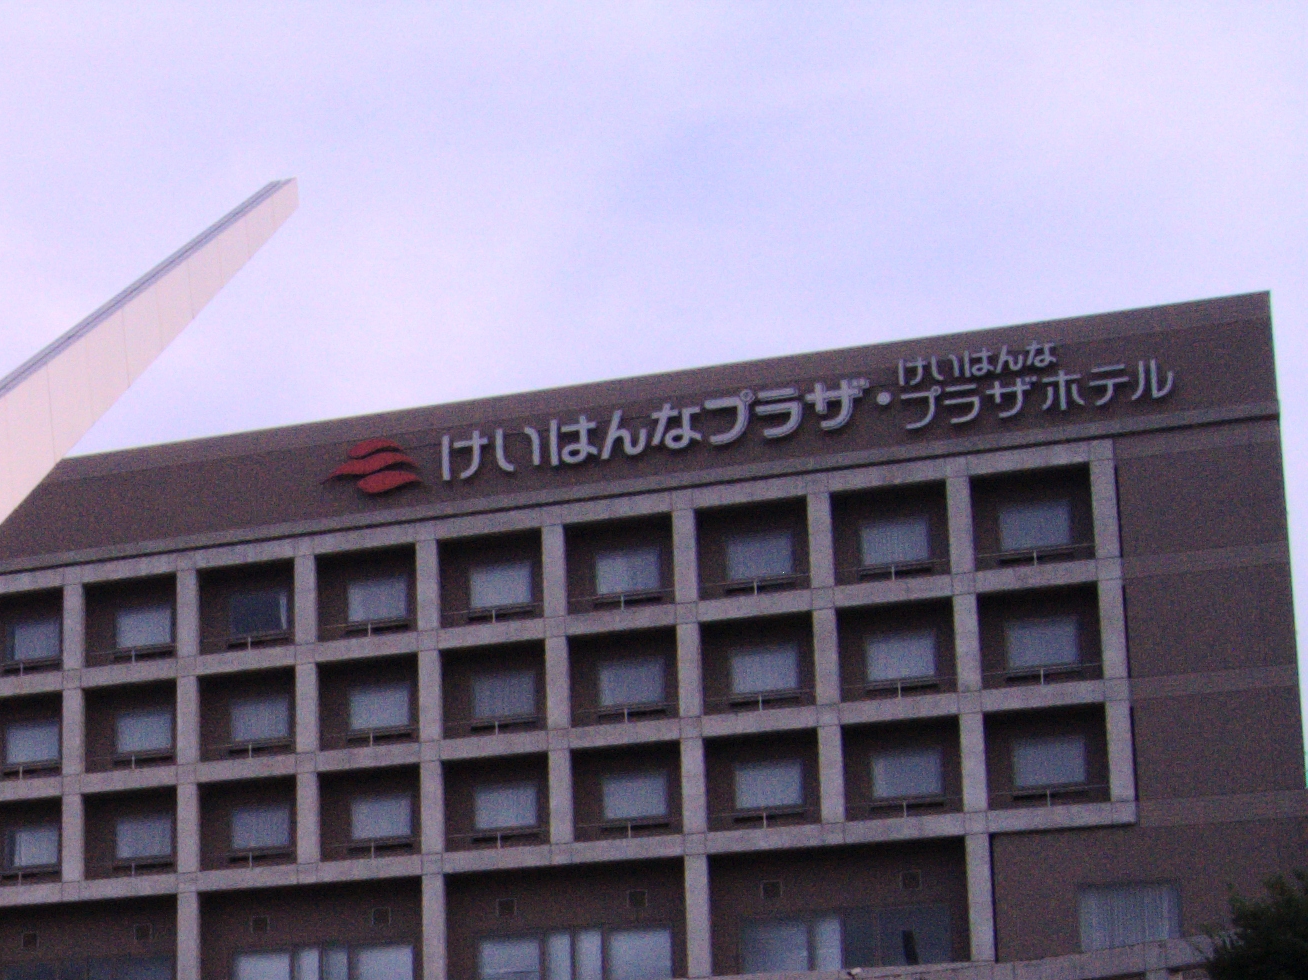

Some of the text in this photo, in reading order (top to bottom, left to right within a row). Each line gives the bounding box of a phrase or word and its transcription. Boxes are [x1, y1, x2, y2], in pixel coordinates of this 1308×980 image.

[898, 340, 1057, 386] けいはんな
[900, 358, 1174, 430] プラザホテル
